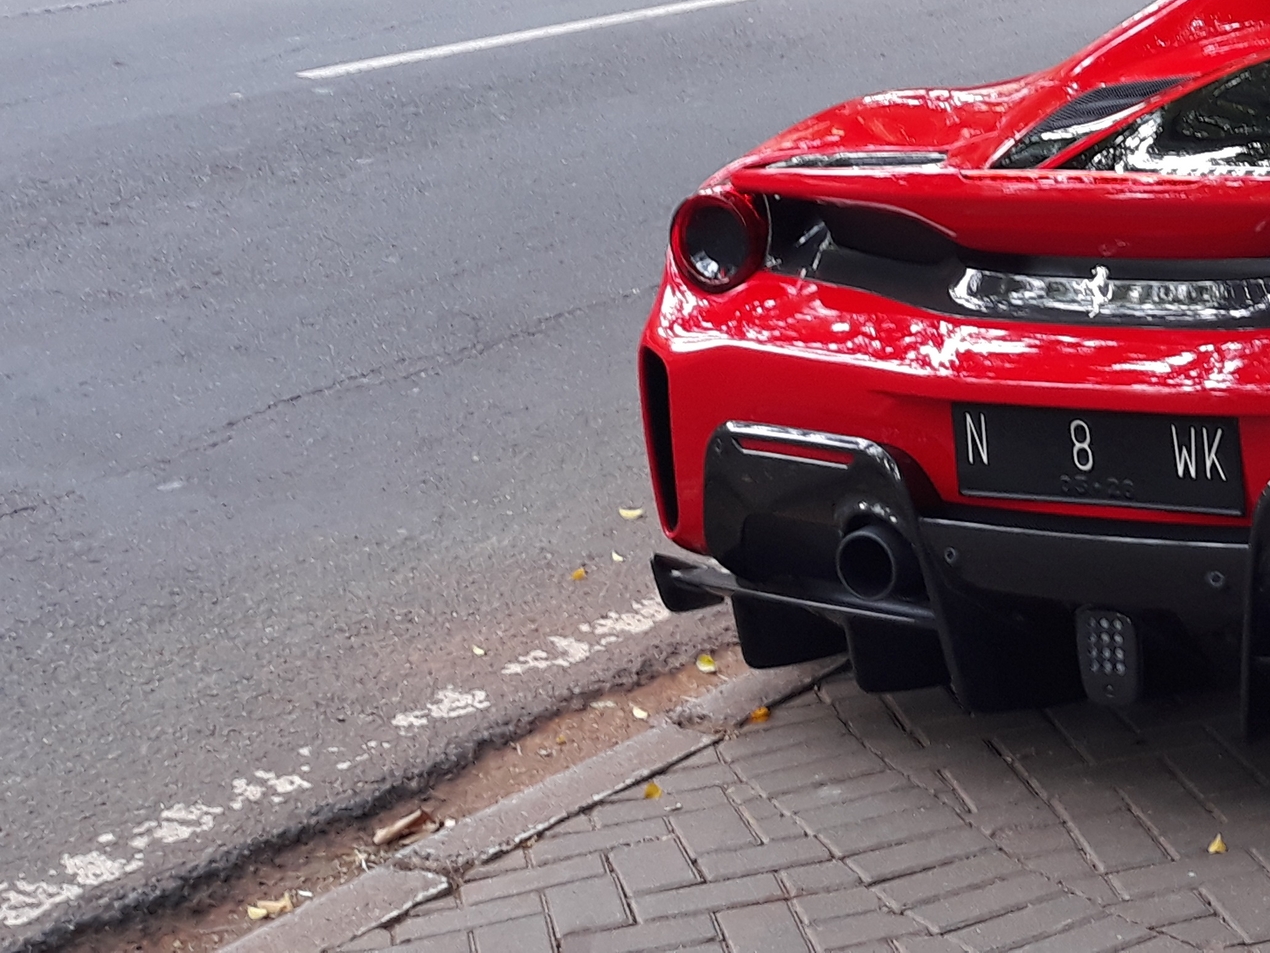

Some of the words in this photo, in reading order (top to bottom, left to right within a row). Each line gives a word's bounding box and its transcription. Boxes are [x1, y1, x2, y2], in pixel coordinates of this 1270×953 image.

[964, 412, 990, 466] N
[1069, 418, 1095, 472] 8
[1170, 424, 1228, 482] WK
